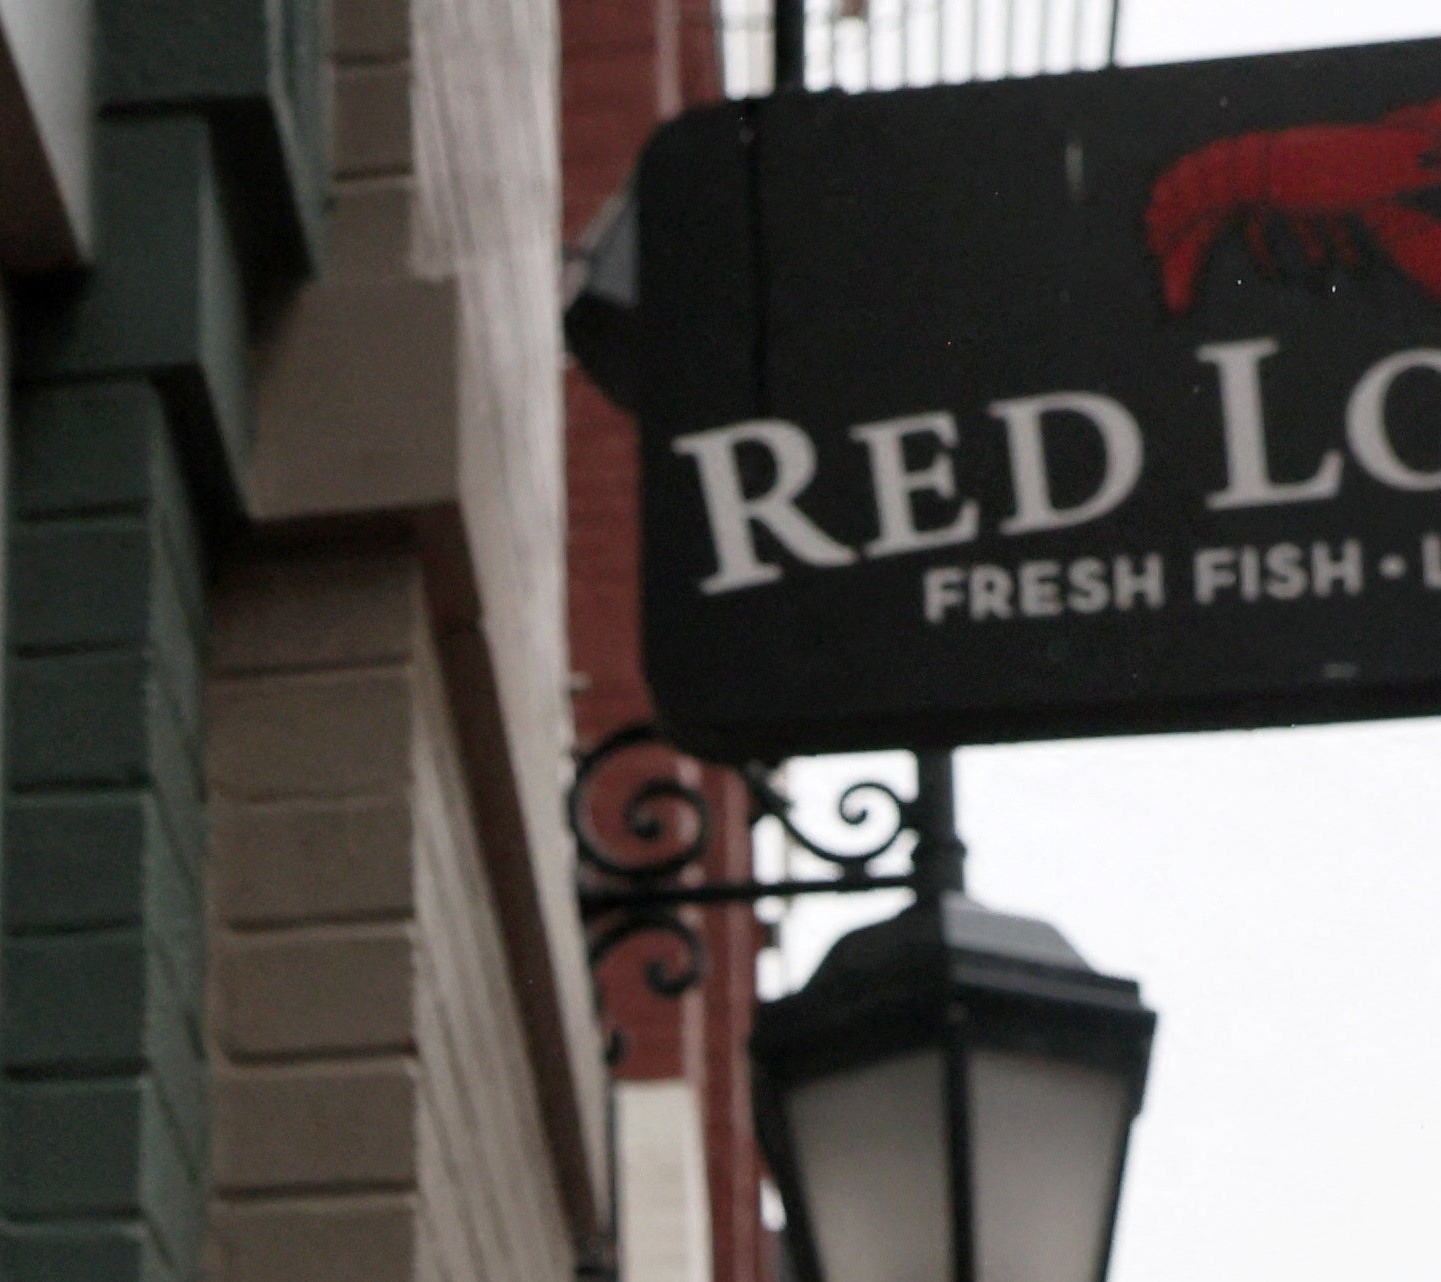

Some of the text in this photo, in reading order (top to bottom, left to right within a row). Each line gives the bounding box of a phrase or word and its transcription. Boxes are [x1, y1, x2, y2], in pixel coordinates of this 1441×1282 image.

[671, 390, 1145, 596] RED
[922, 553, 1165, 624] FRESH
[1193, 539, 1364, 605] FISH
